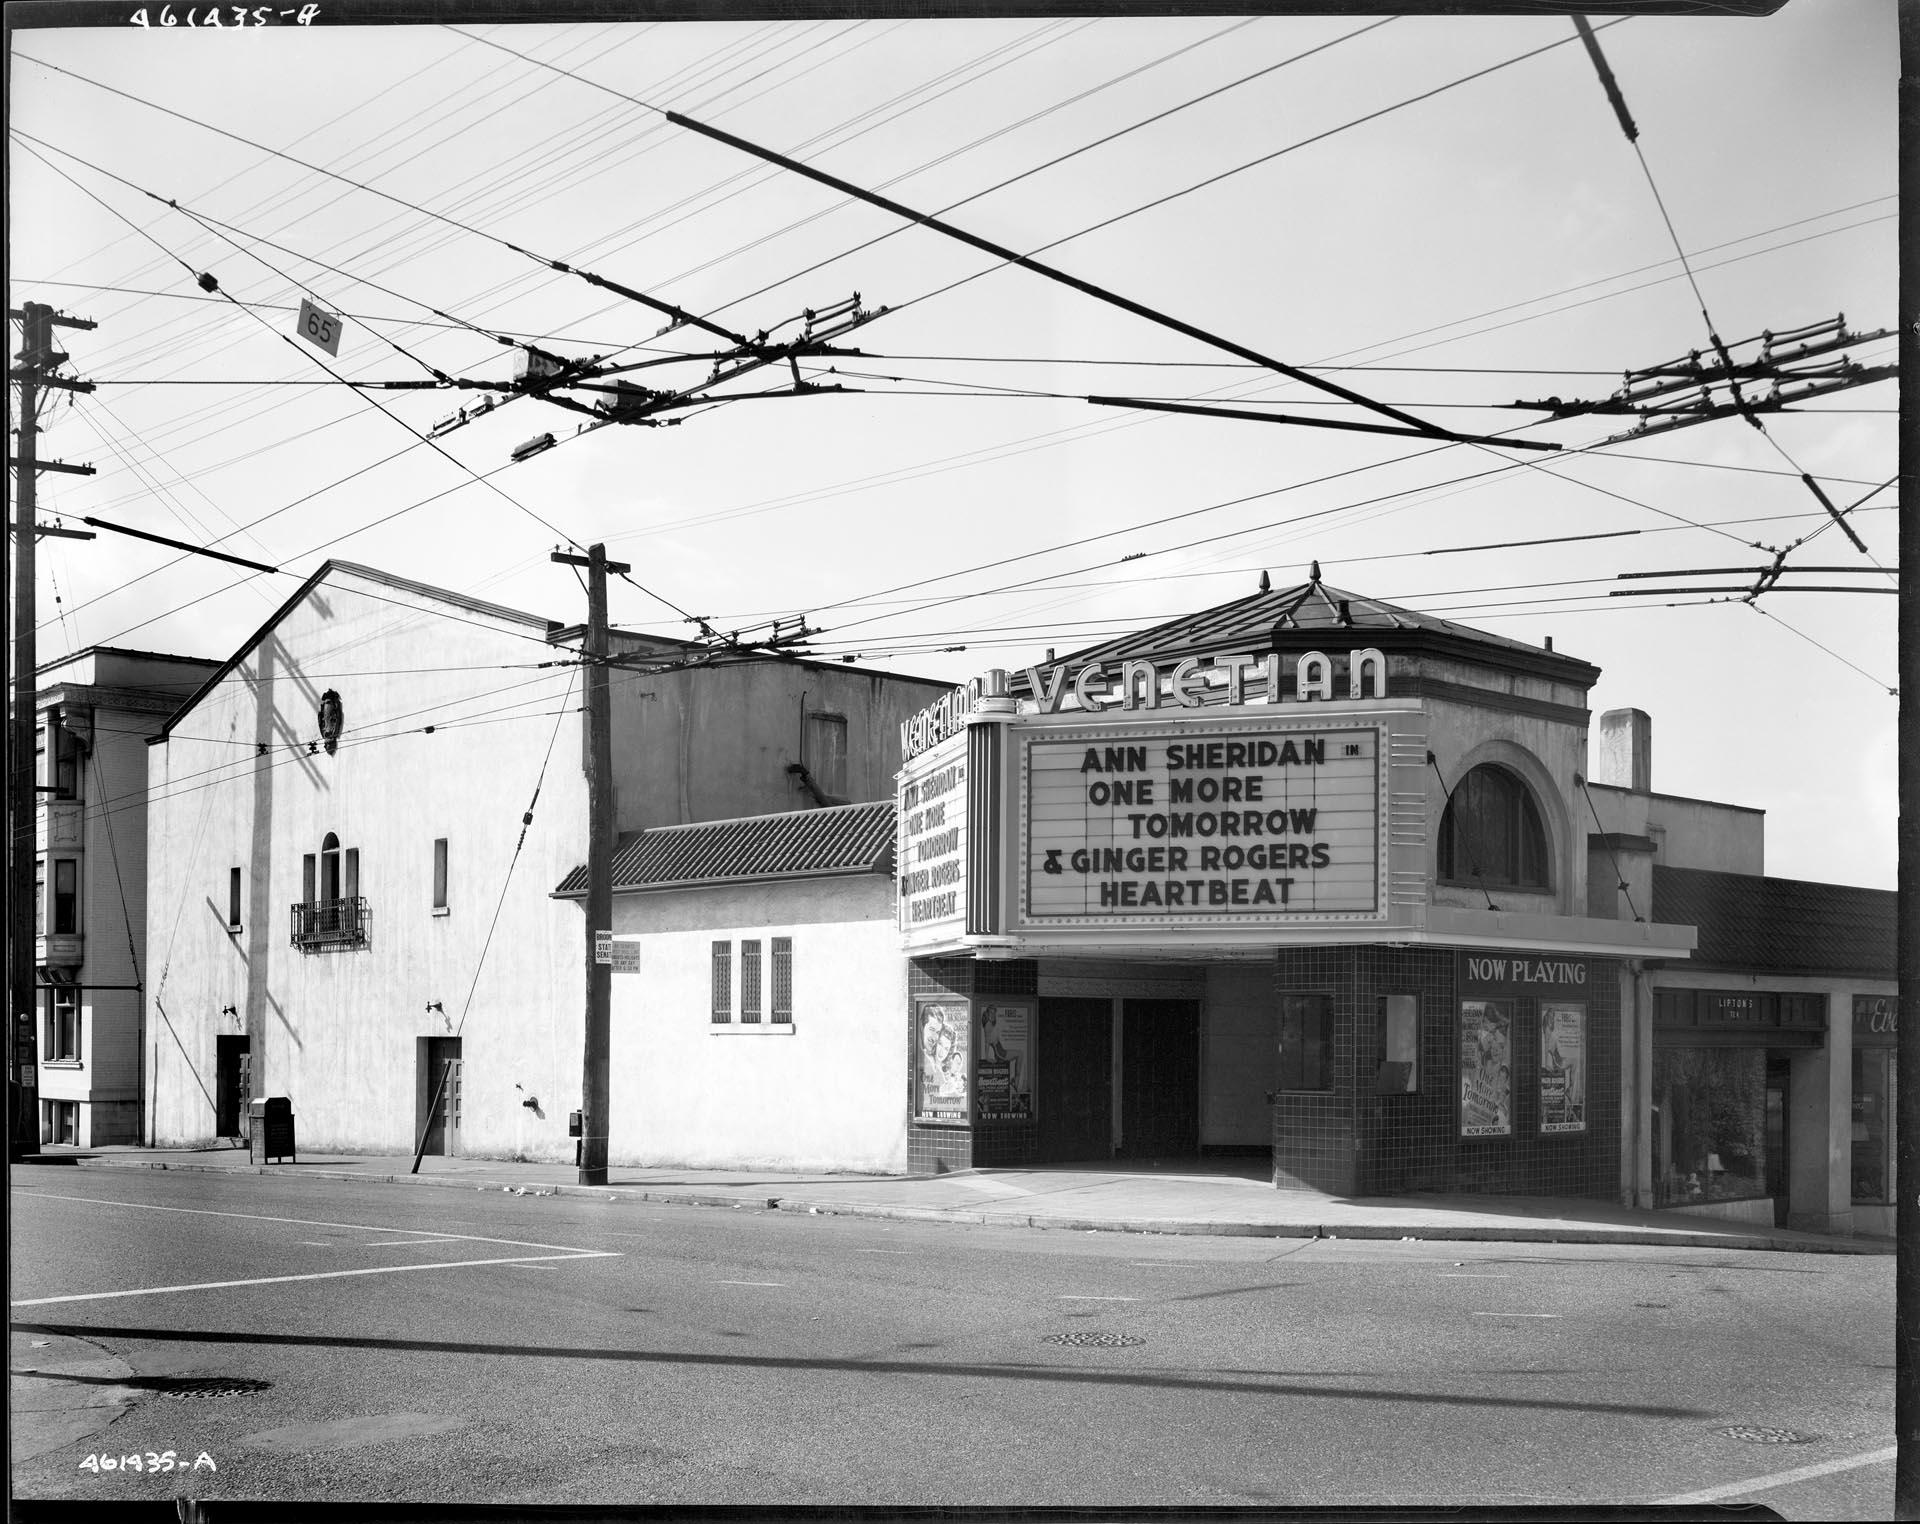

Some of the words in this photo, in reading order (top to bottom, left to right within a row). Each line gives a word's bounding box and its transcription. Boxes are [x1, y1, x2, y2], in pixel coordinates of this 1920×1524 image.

[307, 312, 332, 343] 65
[1026, 647, 1388, 714] VENETIAN
[1080, 746, 1147, 773] ANN
[1166, 739, 1325, 771] SHERIDAN
[1345, 744, 1360, 756] IN
[921, 765, 957, 804] SHERIDAN
[1089, 780, 1154, 806] ONE
[1170, 776, 1263, 804] MORE
[909, 811, 923, 836] ONE
[925, 802, 945, 831] MORE
[1127, 808, 1318, 839] TOMORROW
[917, 827, 959, 863] TOMORROW
[1043, 850, 1062, 875] &
[1071, 846, 1188, 874] GINGER
[1201, 842, 1330, 872] ROGERS
[931, 859, 960, 889] ROGERS
[912, 891, 957, 923] HEARTBEAT
[1100, 878, 1294, 906] HEARTBEAT
[1468, 957, 1507, 981] NOW
[1511, 960, 1587, 984] PLAYING
[1466, 1127, 1480, 1135] NOW
[1481, 1126, 1506, 1134] SHOWING
